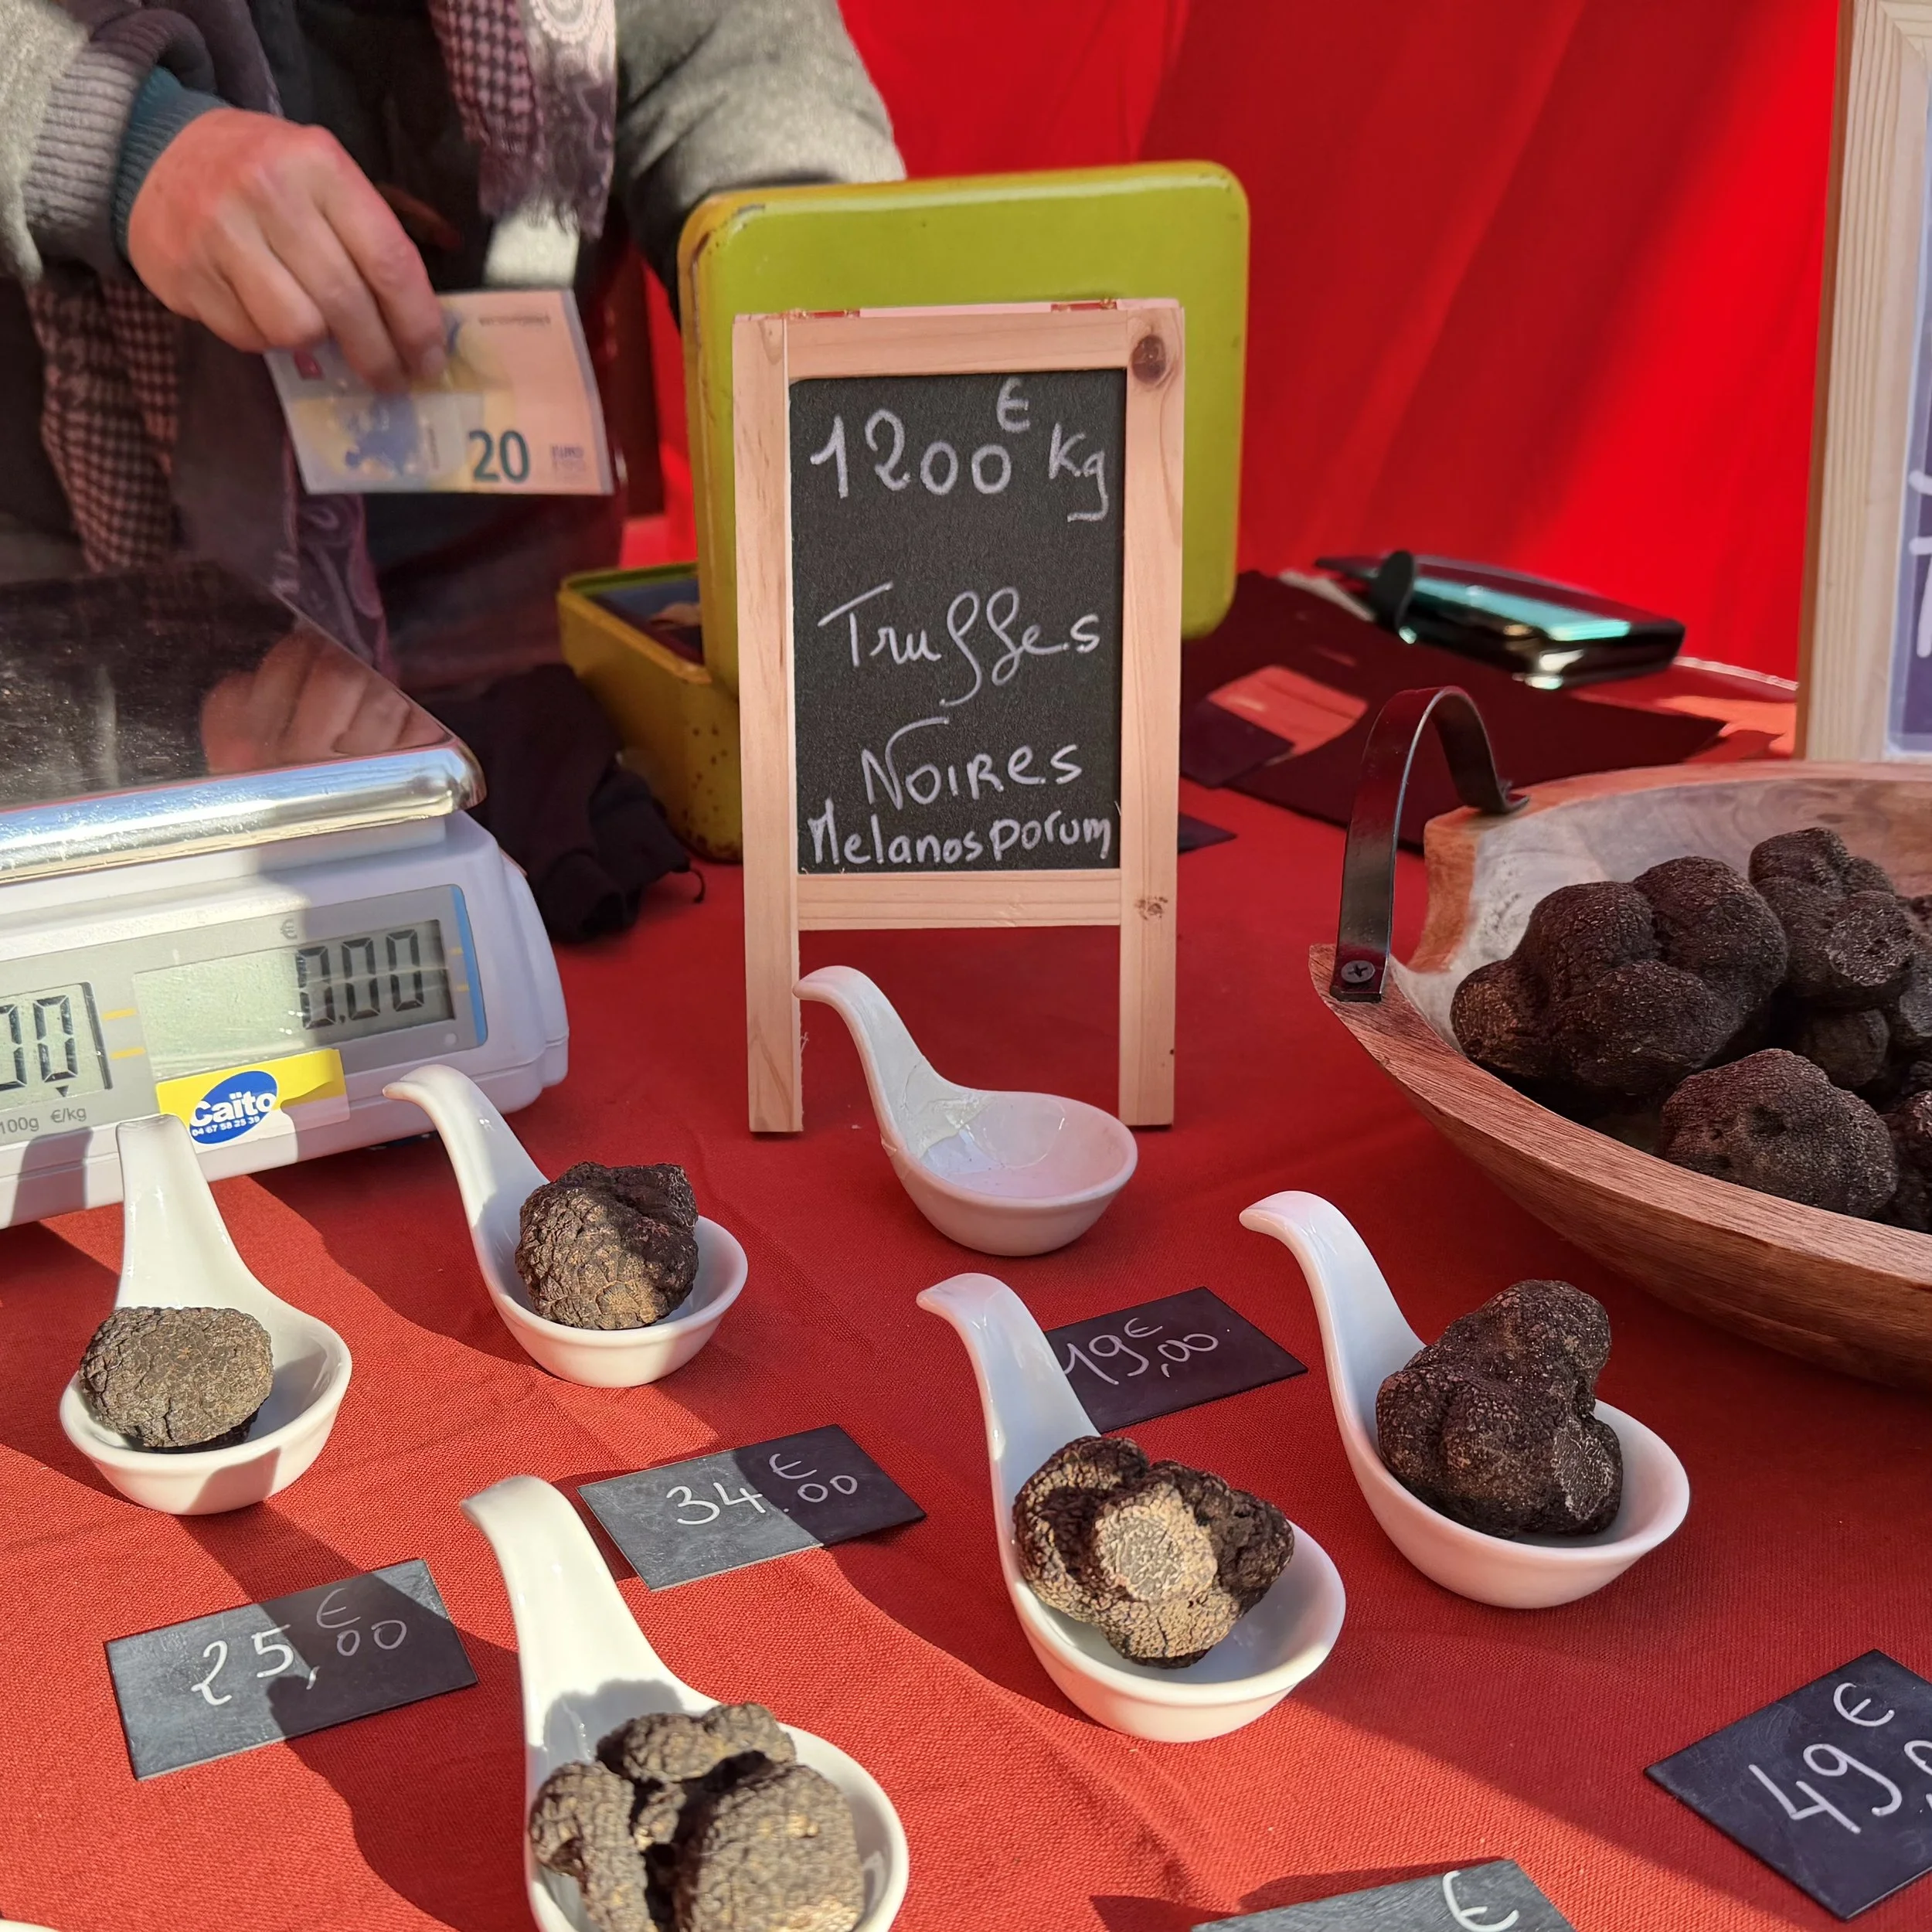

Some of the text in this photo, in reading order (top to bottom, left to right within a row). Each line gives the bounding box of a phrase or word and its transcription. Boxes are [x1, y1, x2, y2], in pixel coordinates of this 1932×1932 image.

[468, 430, 531, 483] 20
[818, 581, 1100, 707] Truffes
[281, 919, 298, 940] €
[50, 1108, 87, 1124] €/kg
[189, 1090, 277, 1127] Caïto
[192, 1128, 205, 1137] 04
[205, 1124, 218, 1134] 67
[219, 1121, 233, 1131] 58
